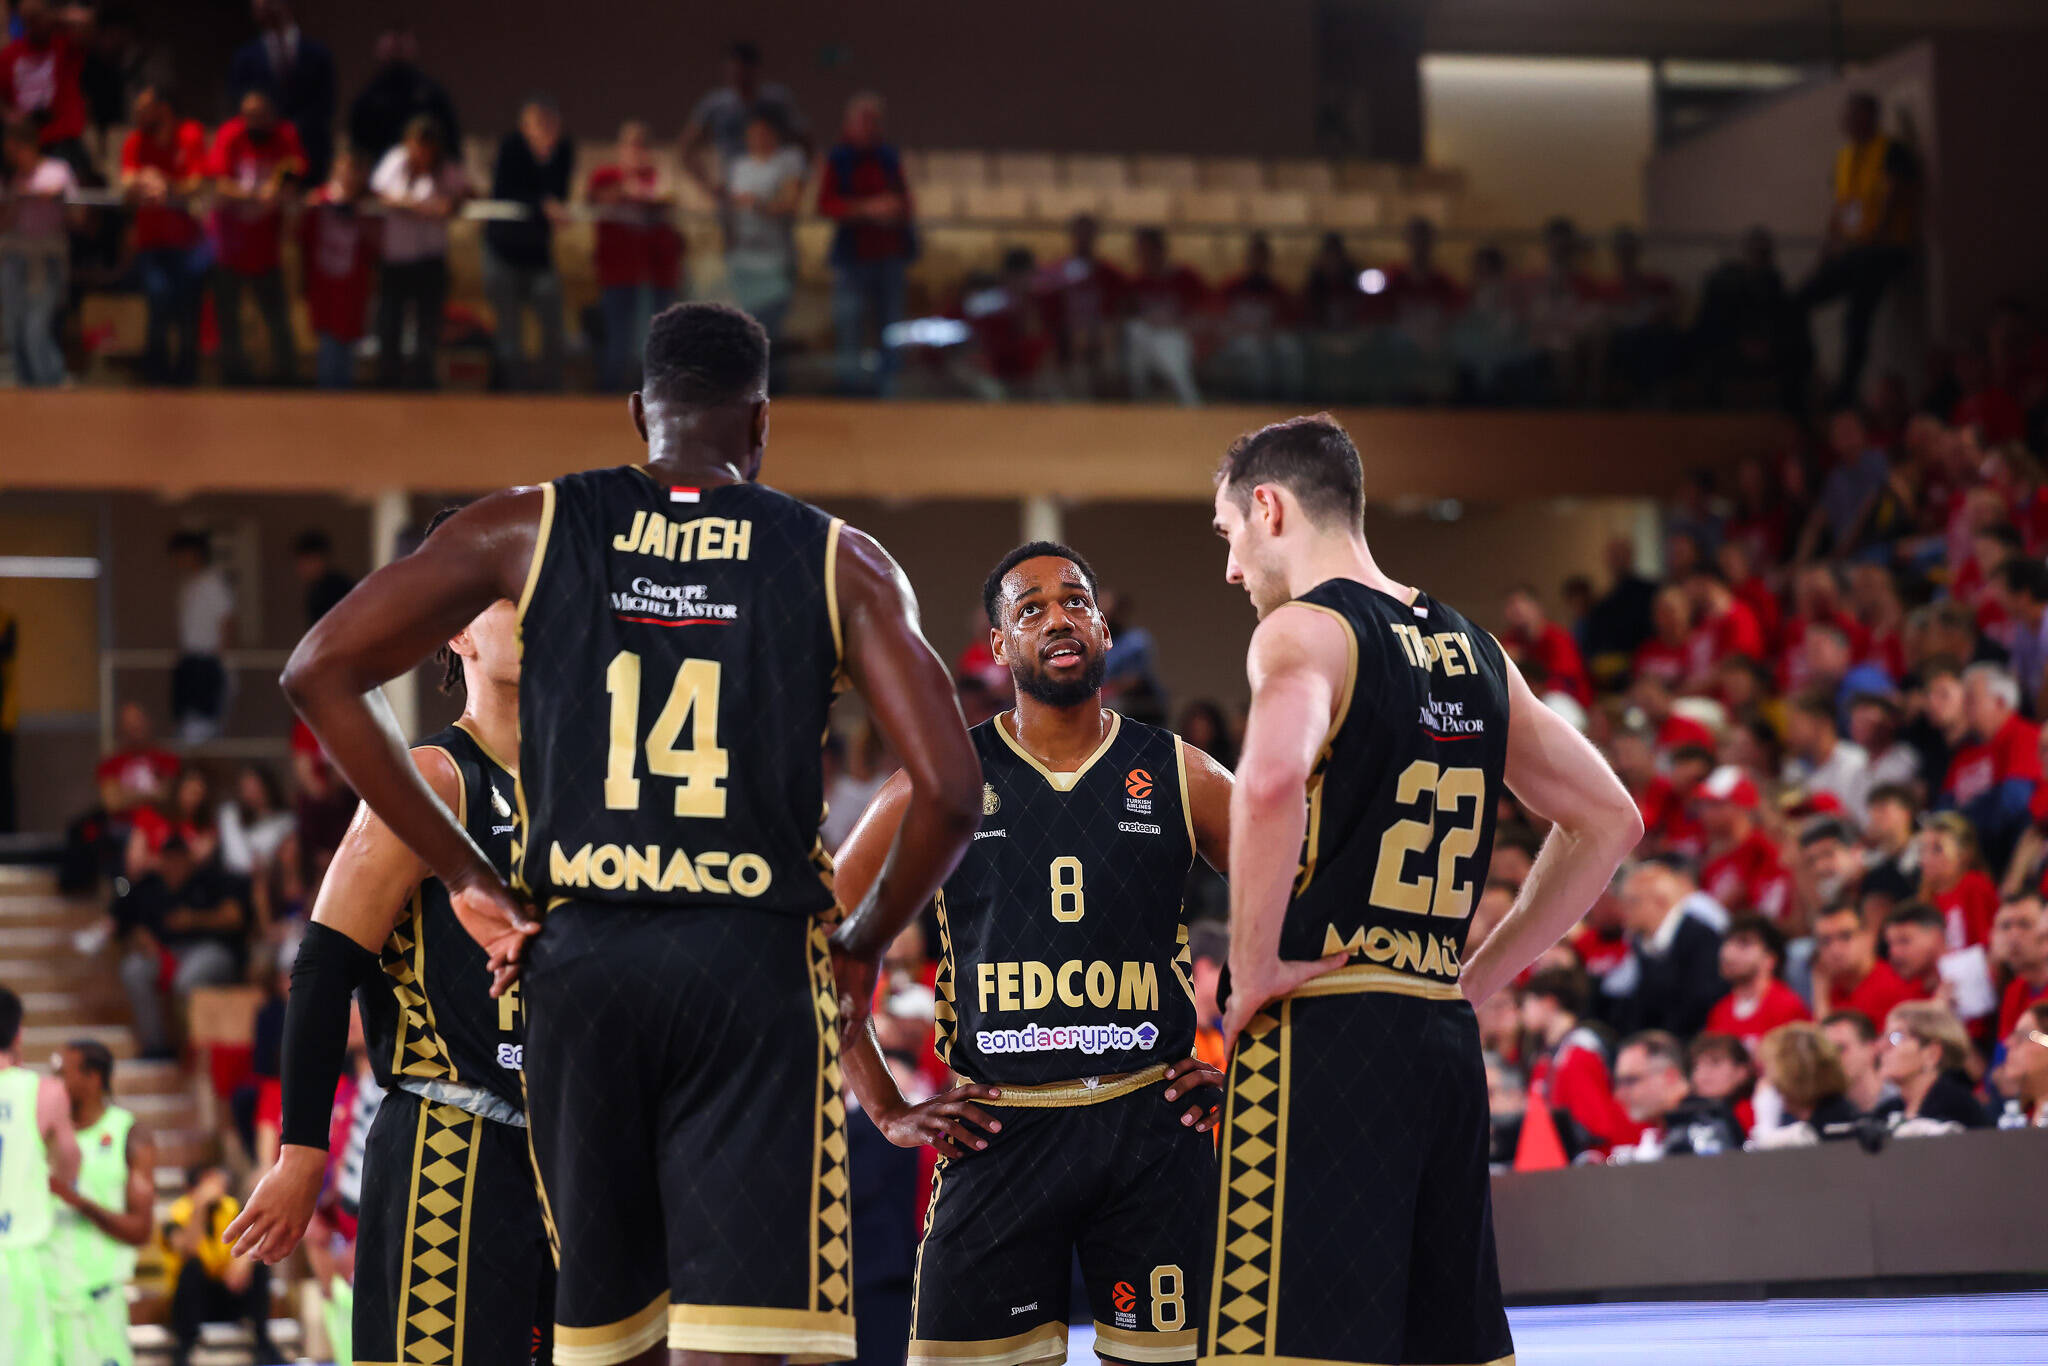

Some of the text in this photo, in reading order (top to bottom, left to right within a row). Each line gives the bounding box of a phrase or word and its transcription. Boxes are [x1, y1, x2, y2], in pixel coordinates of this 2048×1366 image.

[612, 510, 752, 562] JAITEH
[676, 600, 738, 619] PASTOR
[1390, 623, 1478, 677] TAPEY
[604, 650, 728, 818] 14
[973, 829, 1007, 841] SPALDING
[1118, 821, 1161, 834] oneteam
[1368, 759, 1485, 919] 22
[550, 840, 772, 898] MONACO
[1050, 856, 1085, 923] 8
[1321, 922, 1459, 977] MONAC
[977, 959, 1159, 1013] FEDCOM
[978, 1025, 1135, 1054] zondacrypto
[1011, 1301, 1038, 1315] SPALDING
[1115, 1311, 1136, 1319] TURKISH
[1150, 1264, 1186, 1332] 8
